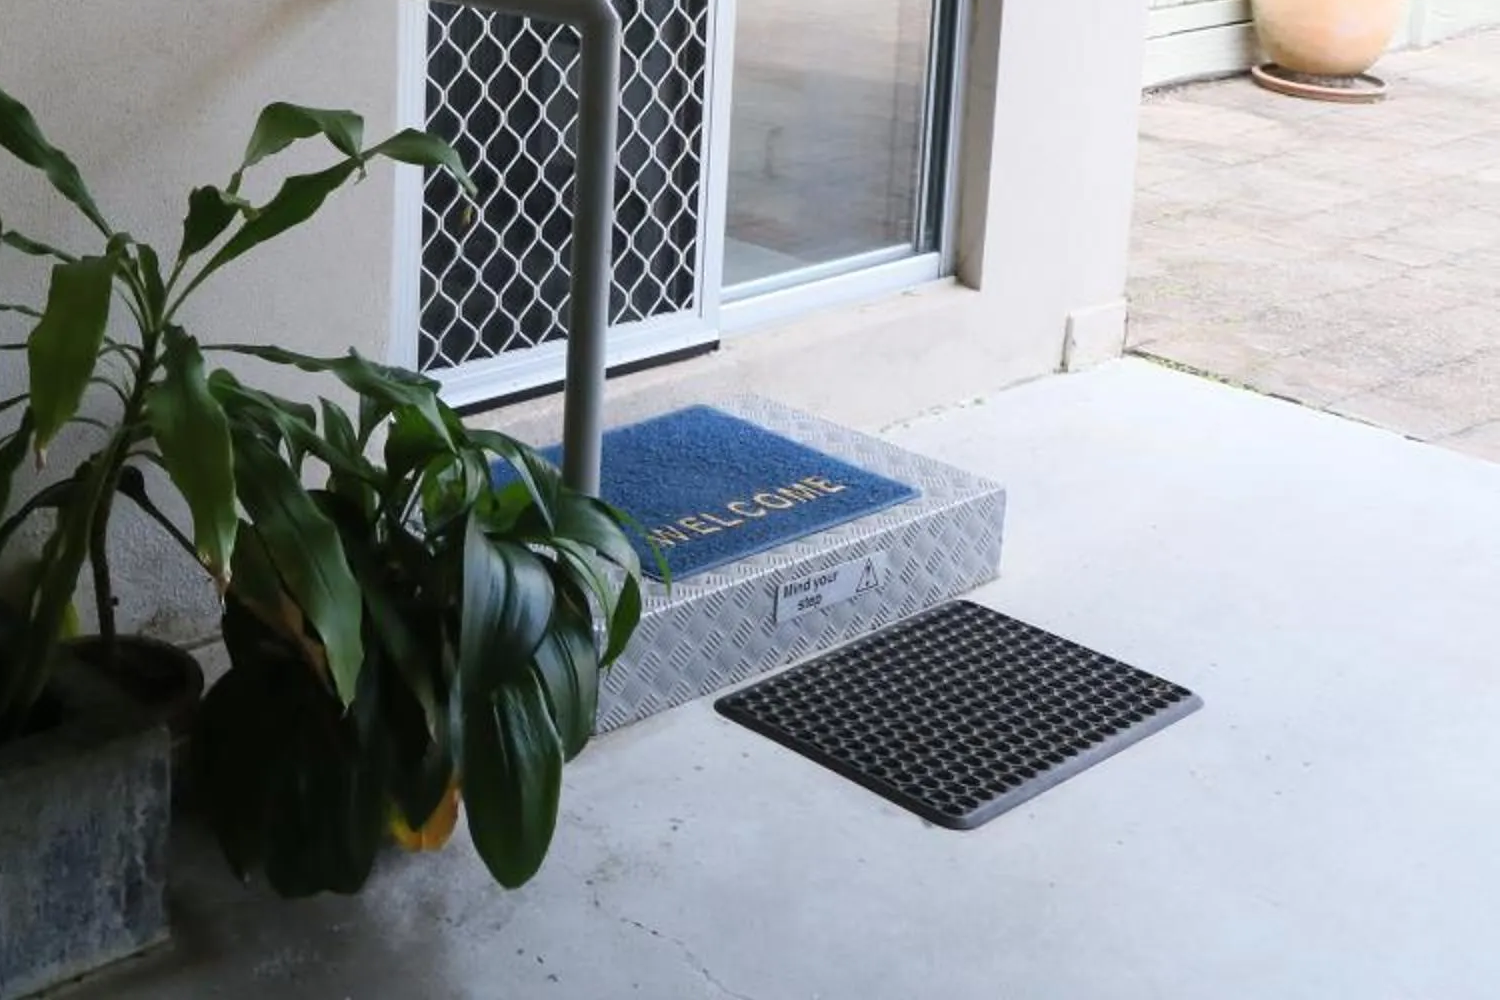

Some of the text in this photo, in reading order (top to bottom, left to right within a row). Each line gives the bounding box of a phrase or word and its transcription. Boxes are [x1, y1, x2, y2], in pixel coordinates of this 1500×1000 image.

[650, 475, 847, 548] WELCOME
[784, 571, 838, 598] Mind your
